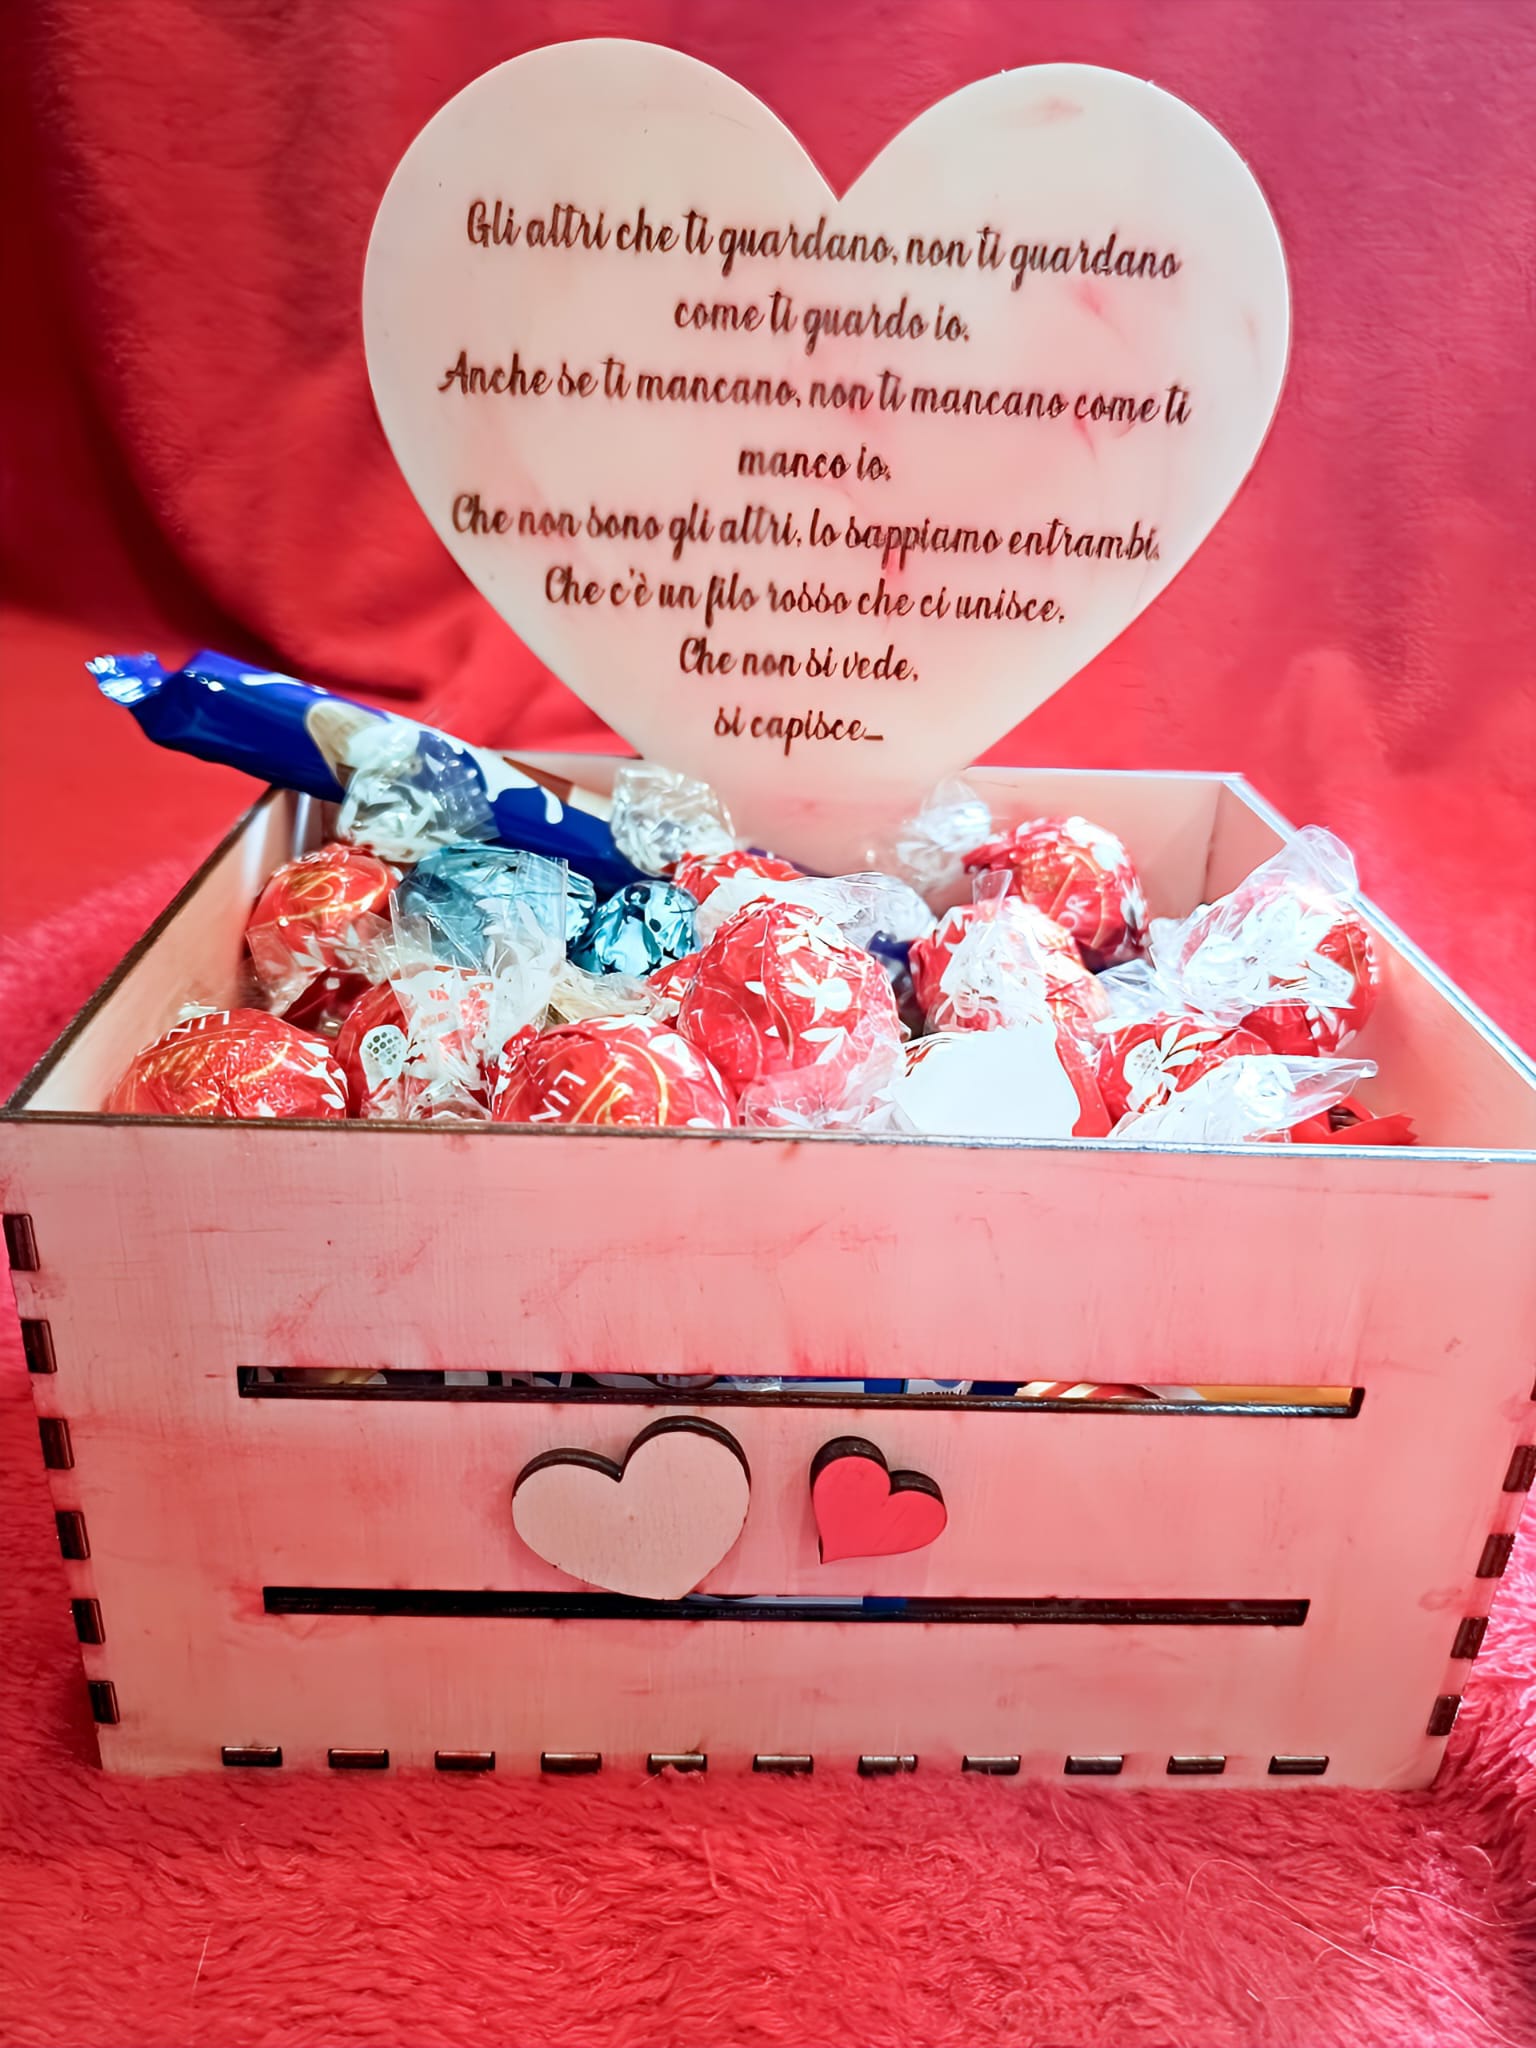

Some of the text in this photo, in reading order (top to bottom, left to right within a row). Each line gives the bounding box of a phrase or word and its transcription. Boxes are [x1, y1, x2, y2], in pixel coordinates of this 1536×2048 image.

[466, 200, 1182, 292] Gli altri che ti guardano, non ti guardano
[674, 300, 765, 331] come
[767, 290, 797, 334] ti
[802, 297, 929, 356] guardo
[438, 350, 1193, 426] Anche se ti mancano, non ti mancano come ti
[737, 448, 852, 479] manco
[451, 493, 514, 537] Che
[517, 505, 582, 539] non
[585, 504, 664, 542] sono
[667, 501, 717, 562] gli
[808, 507, 842, 548] lo
[844, 516, 1004, 573] sappiamo
[544, 565, 605, 607] Che
[657, 580, 703, 612] un
[704, 571, 761, 630] filo
[767, 580, 851, 615] rosso
[856, 577, 916, 618] che
[918, 586, 951, 620] ci
[678, 636, 737, 677] Che
[740, 651, 803, 678] non
[804, 646, 838, 678] si
[712, 705, 746, 738] si
